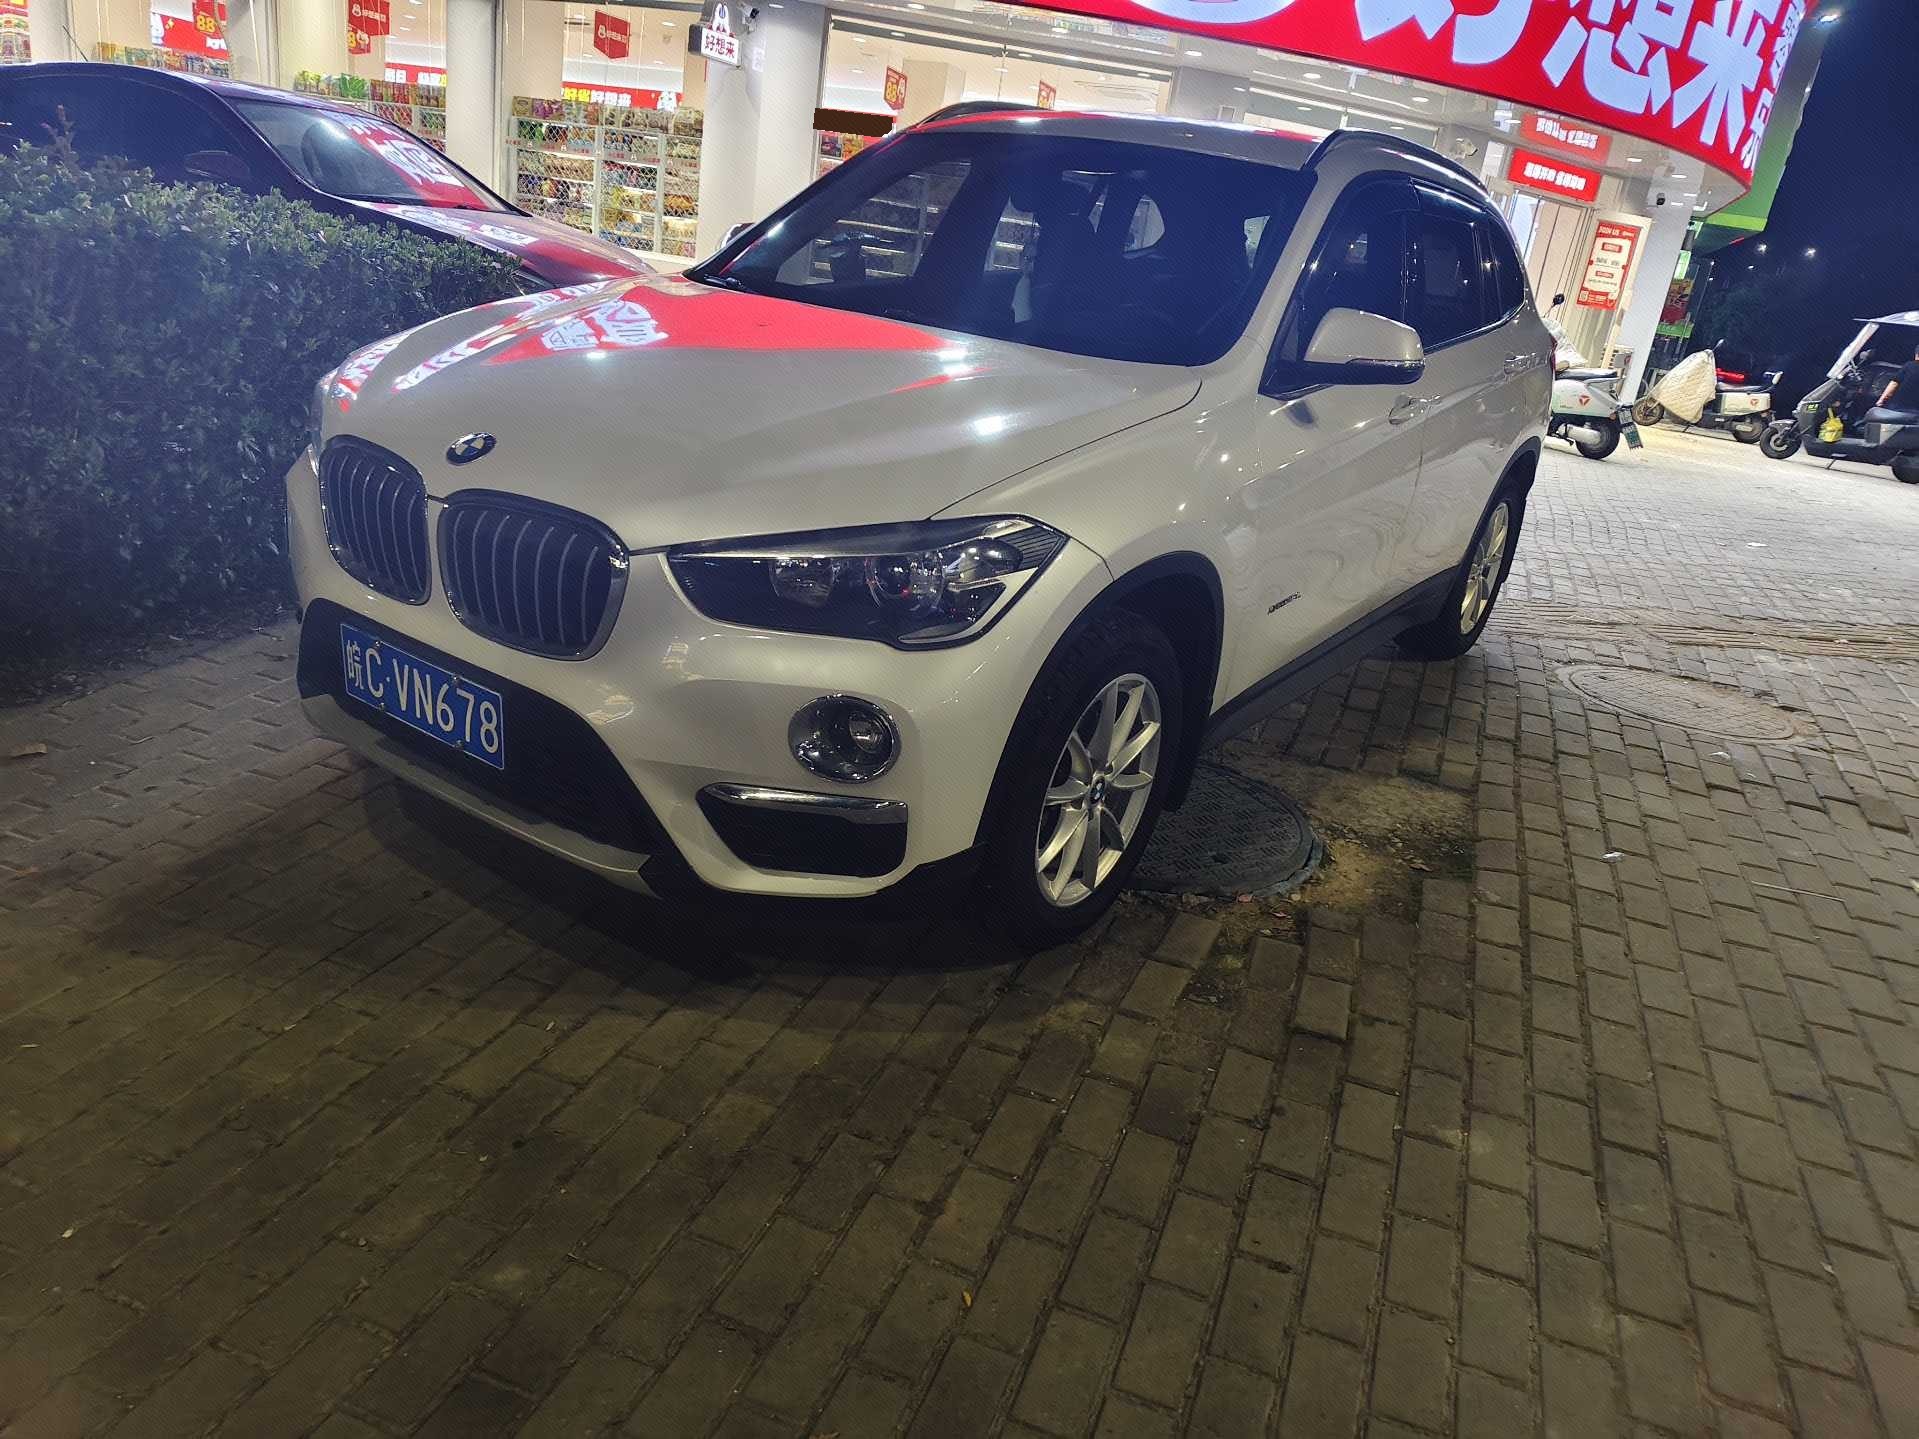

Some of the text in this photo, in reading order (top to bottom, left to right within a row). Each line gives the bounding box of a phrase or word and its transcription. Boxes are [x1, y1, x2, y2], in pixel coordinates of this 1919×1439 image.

[705, 33, 736, 59] 好想来
[347, 640, 499, 754] 皖C·VN678
